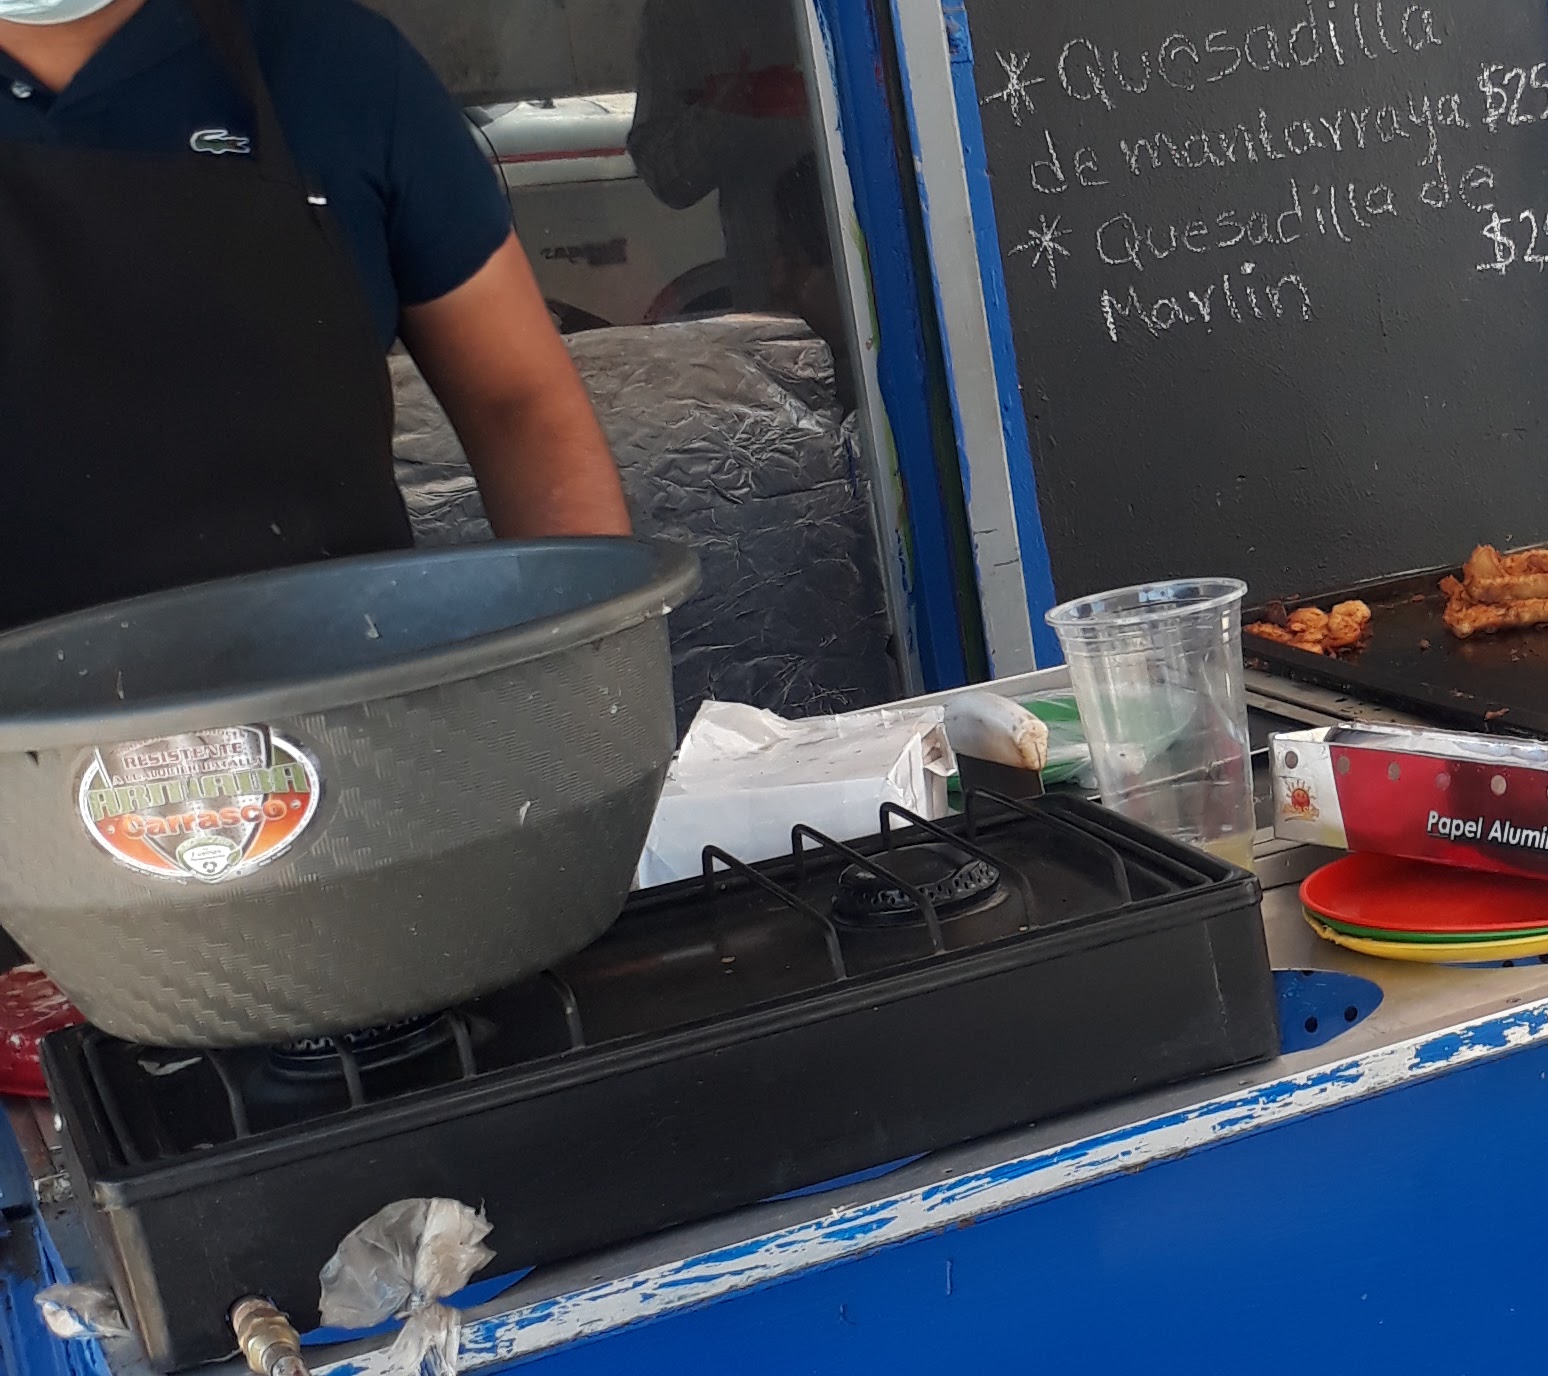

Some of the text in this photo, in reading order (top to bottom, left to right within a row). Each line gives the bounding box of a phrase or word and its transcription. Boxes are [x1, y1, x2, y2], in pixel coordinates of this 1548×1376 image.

[1030, 129, 1110, 195] de
[1119, 87, 1472, 177] mantarraya
[1096, 178, 1399, 272] Quesadilla
[1419, 155, 1496, 213] de
[123, 741, 244, 771] RESISTENTE
[121, 799, 288, 841] Carrasco
[1427, 810, 1483, 841] Papel
